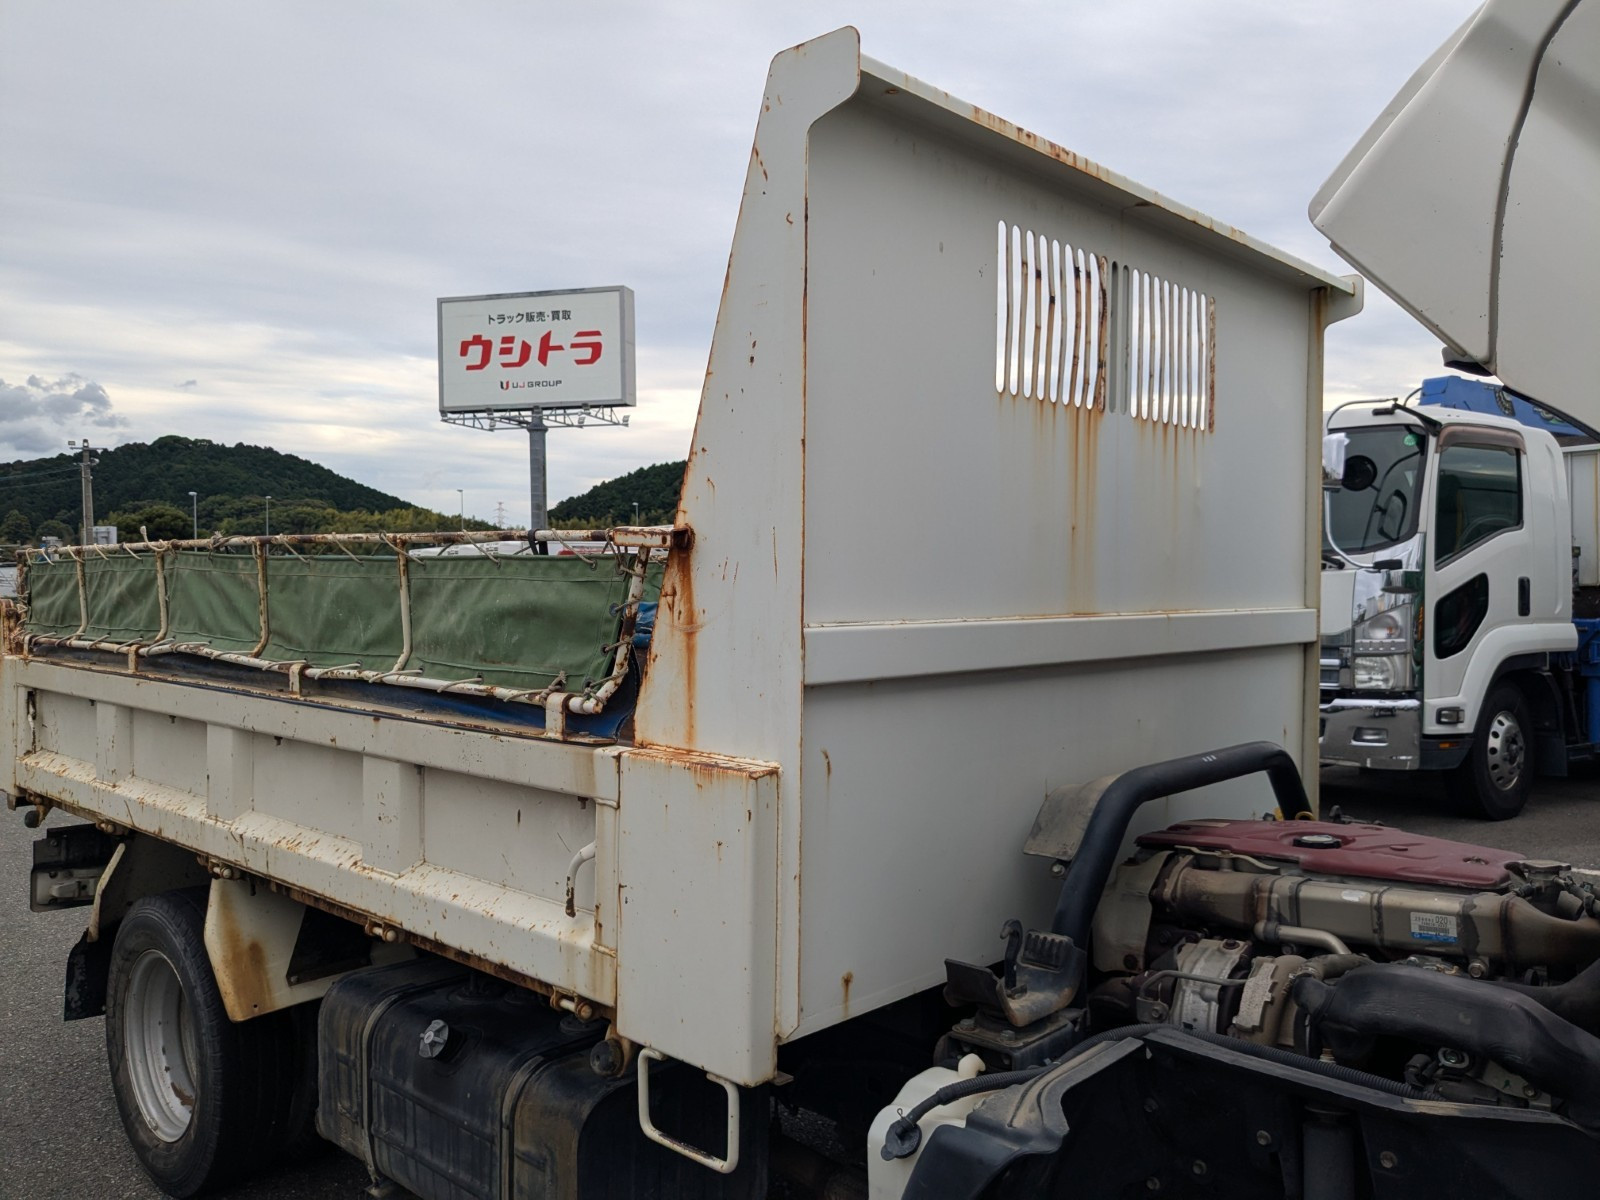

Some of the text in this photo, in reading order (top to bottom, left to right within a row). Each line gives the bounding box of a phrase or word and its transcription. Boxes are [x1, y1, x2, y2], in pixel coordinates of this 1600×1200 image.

[488, 310, 572, 325] トラック販売・買取
[460, 330, 603, 371] ウシトラ
[527, 379, 563, 388] GROUP
